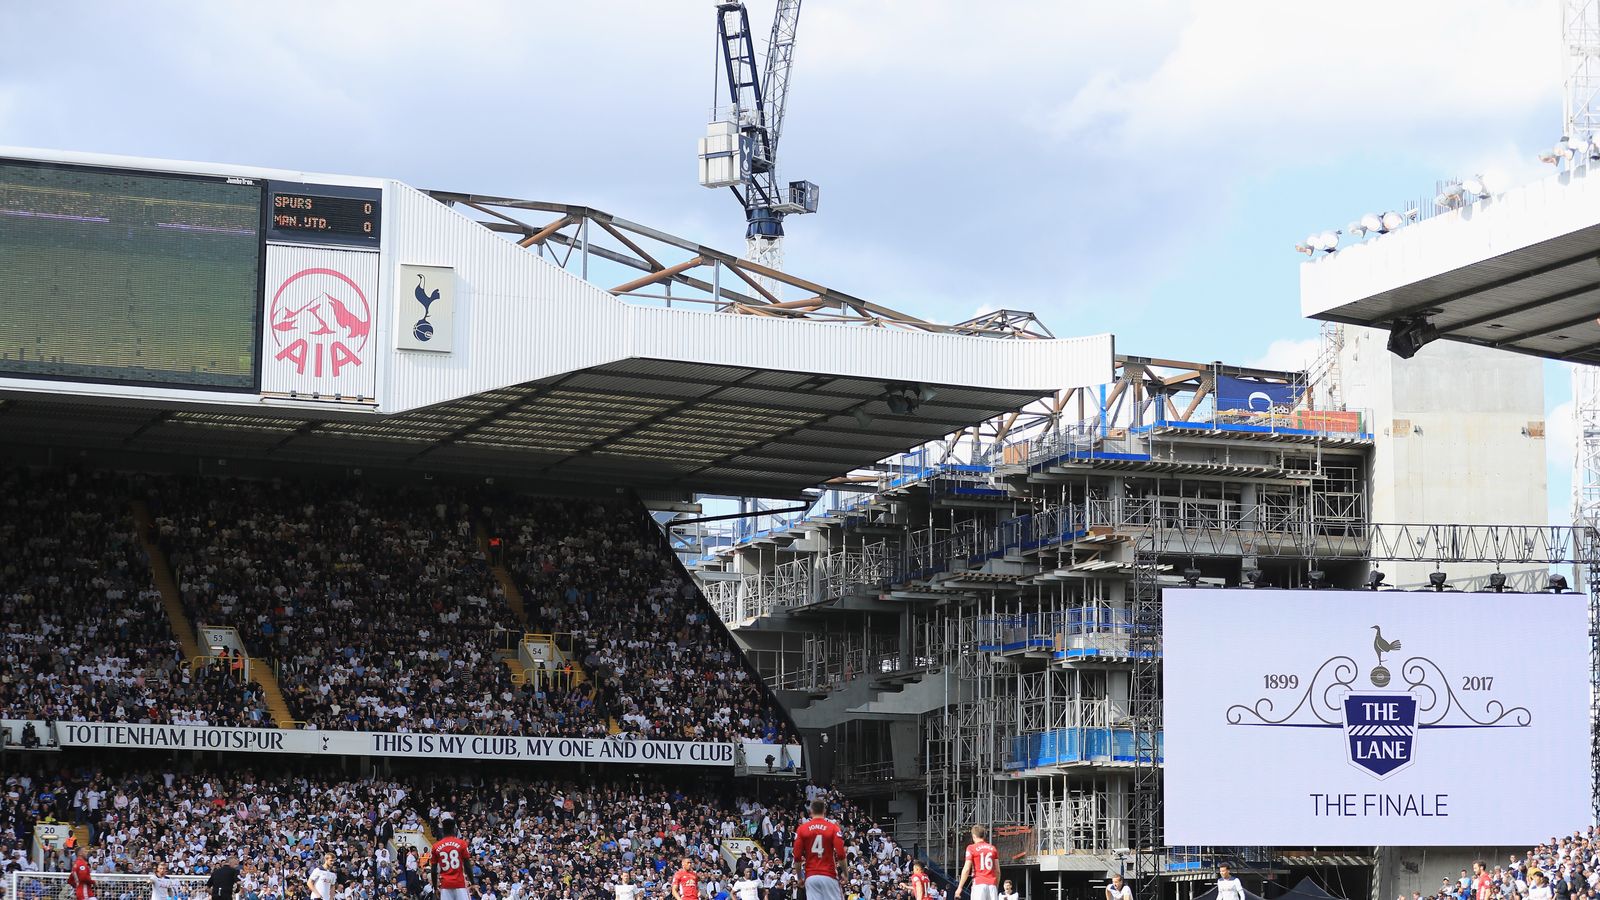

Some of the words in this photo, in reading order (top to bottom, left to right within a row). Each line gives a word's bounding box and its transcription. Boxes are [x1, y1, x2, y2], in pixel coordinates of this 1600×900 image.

[274, 196, 312, 210] SPURS
[363, 203, 373, 215] 0
[363, 221, 373, 233] 0
[274, 338, 362, 378] AIA
[213, 634, 223, 642] 53
[532, 647, 542, 655] 54
[1263, 674, 1299, 690] 1899
[1462, 676, 1494, 691] 2017
[1362, 703, 1400, 721] THE
[66, 724, 186, 747] TOTTENHAM
[193, 730, 284, 750] HOTSPUR
[372, 734, 413, 752] THIS
[418, 735, 434, 753] IS
[439, 736, 467, 754] MY
[472, 737, 521, 758] CLUB,
[526, 739, 554, 756] MY
[558, 739, 594, 757] ONE
[599, 741, 637, 758] AND
[642, 742, 685, 760] ONLY
[690, 744, 733, 761] CLUB
[1356, 741, 1407, 759] LANE
[1310, 794, 1357, 816] THE
[1364, 794, 1448, 816] FINALE
[44, 826, 55, 834] 20
[811, 834, 824, 858] 4
[439, 849, 460, 871] 38
[979, 852, 993, 871] 16
